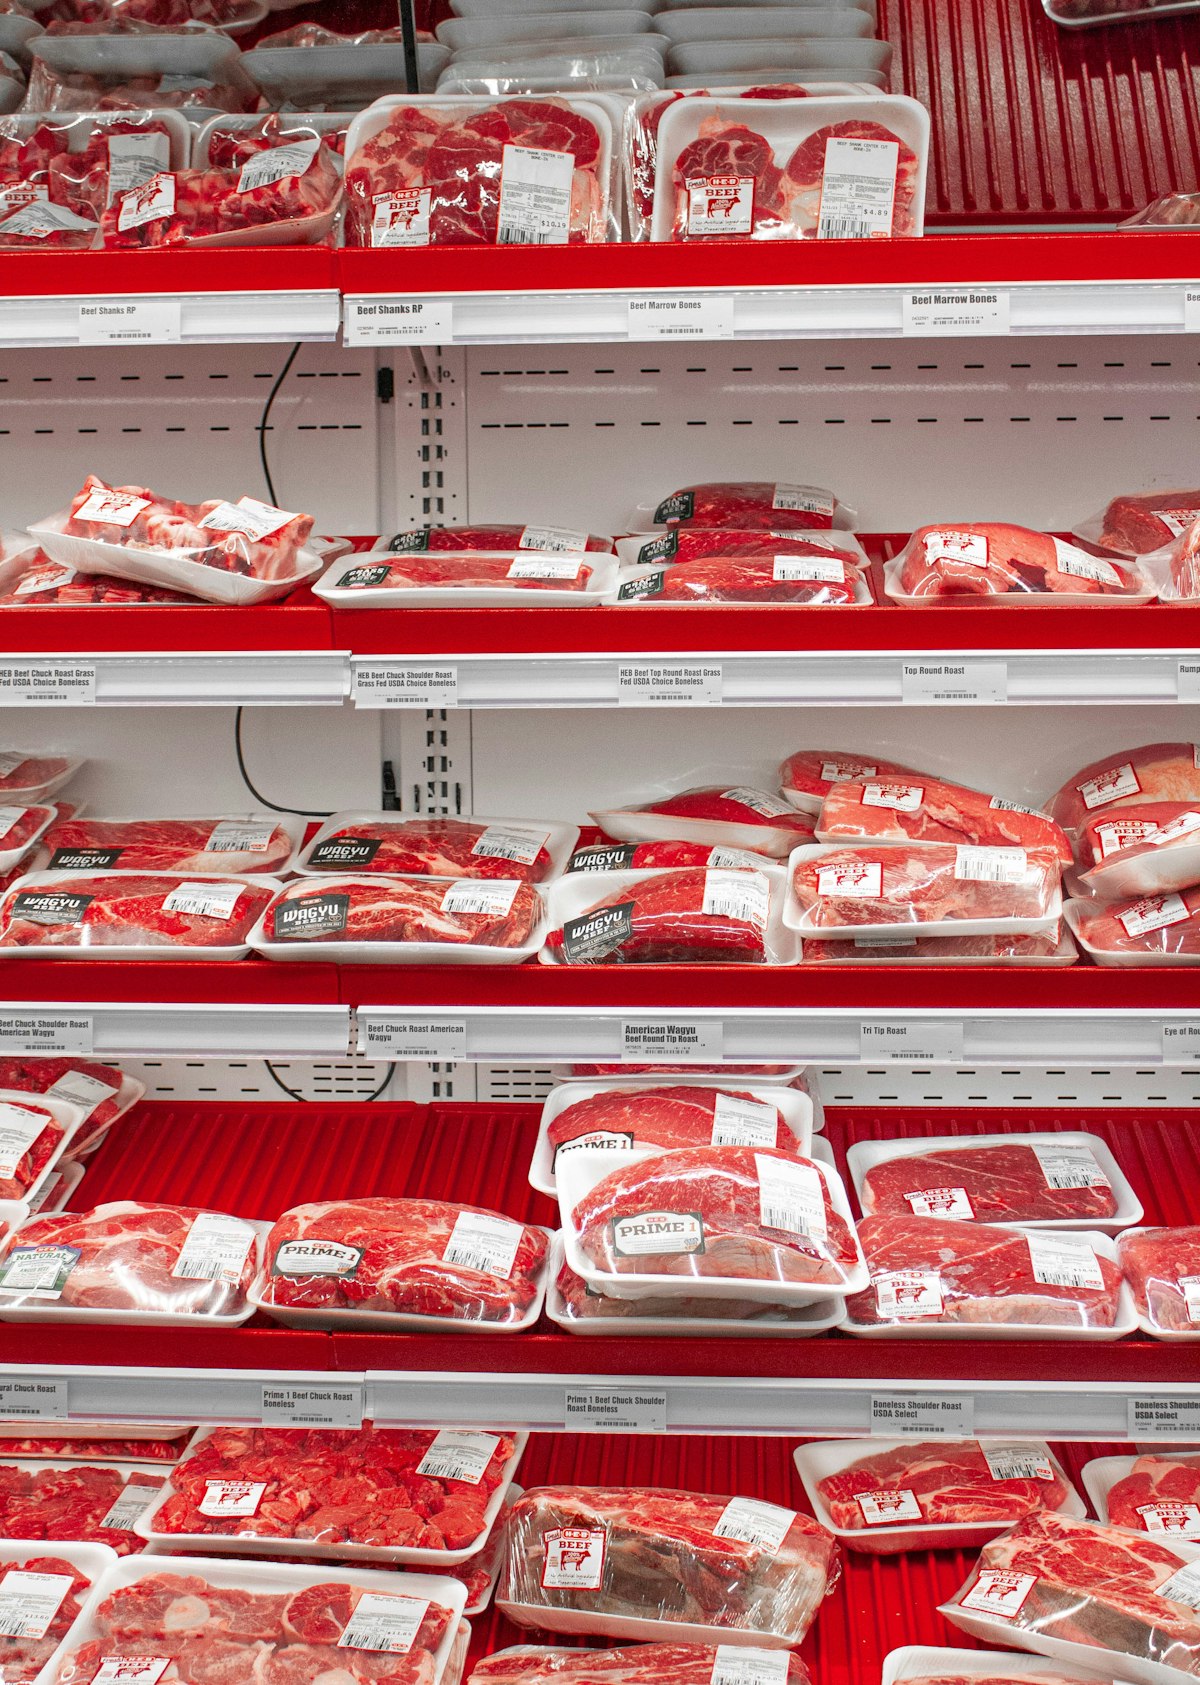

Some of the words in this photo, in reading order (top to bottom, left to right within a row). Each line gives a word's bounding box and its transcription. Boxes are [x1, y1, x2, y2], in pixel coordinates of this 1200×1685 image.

[389, 200, 421, 209] BEEF
[541, 220, 566, 228] $10.19
[912, 295, 932, 304] Beef
[934, 295, 968, 304] Marrow
[969, 294, 997, 303] Bones
[630, 301, 647, 309] Beef
[649, 301, 676, 309] Marrow
[678, 300, 701, 308] Bones
[81, 307, 96, 315] Beef
[99, 306, 125, 314] Shanks
[127, 306, 136, 314] RP
[357, 305, 377, 315] Beef
[378, 305, 410, 314] Shanks
[412, 304, 423, 314] RP
[650, 669, 661, 678] Top
[703, 669, 720, 677] Grass
[905, 667, 917, 675] Top
[1180, 665, 1200, 673] Rump
[407, 671, 434, 679] Shoulder
[436, 671, 452, 679] Roast
[318, 847, 370, 855] WAGYU
[58, 856, 110, 864] WAGYU
[574, 851, 624, 867] WAGYU
[23, 897, 80, 908] WAGYU
[283, 904, 338, 923] WAGYU
[294, 917, 324, 925] BEEF
[572, 911, 622, 939] WAGYU
[583, 925, 610, 940] BEEF
[38, 1020, 68, 1028] Shoulder
[32, 1029, 55, 1038] Wagyu
[409, 1025, 428, 1033] Roast
[430, 1025, 464, 1033] American
[625, 1026, 665, 1034] American
[667, 1026, 696, 1035] Wagyu
[874, 1027, 884, 1035] Tip
[886, 1027, 907, 1035] Roast
[1165, 1028, 1177, 1036] Eye
[368, 1034, 392, 1042] Wagyu
[625, 1035, 641, 1043] Beef
[666, 1035, 677, 1043] Tip
[679, 1035, 698, 1043] Roast
[621, 1140, 627, 1149] 1
[924, 1194, 955, 1202] BEEF
[619, 1223, 684, 1237] PRIME
[689, 1222, 696, 1232] 1
[16, 1252, 66, 1261] NATURAL
[284, 1247, 346, 1258] PRIME
[264, 1391, 284, 1399] Prime
[292, 1392, 308, 1400] Beef
[310, 1392, 331, 1400] Chuck
[333, 1393, 352, 1401] Roast
[567, 1396, 587, 1404] Prime
[589, 1396, 593, 1404] 1
[595, 1396, 610, 1404] Beef
[612, 1396, 633, 1405] Chuck
[635, 1397, 665, 1405] Shoulder
[264, 1400, 295, 1408] Boneless
[873, 1400, 906, 1408] Boneless
[908, 1401, 939, 1409] Shoulder
[942, 1402, 962, 1410] Roast
[587, 1405, 618, 1413] Boneless
[873, 1410, 892, 1418] USDA
[547, 1530, 559, 1540] Fresh
[559, 1541, 592, 1549] BEEF
[992, 1577, 1022, 1585] BEEF
